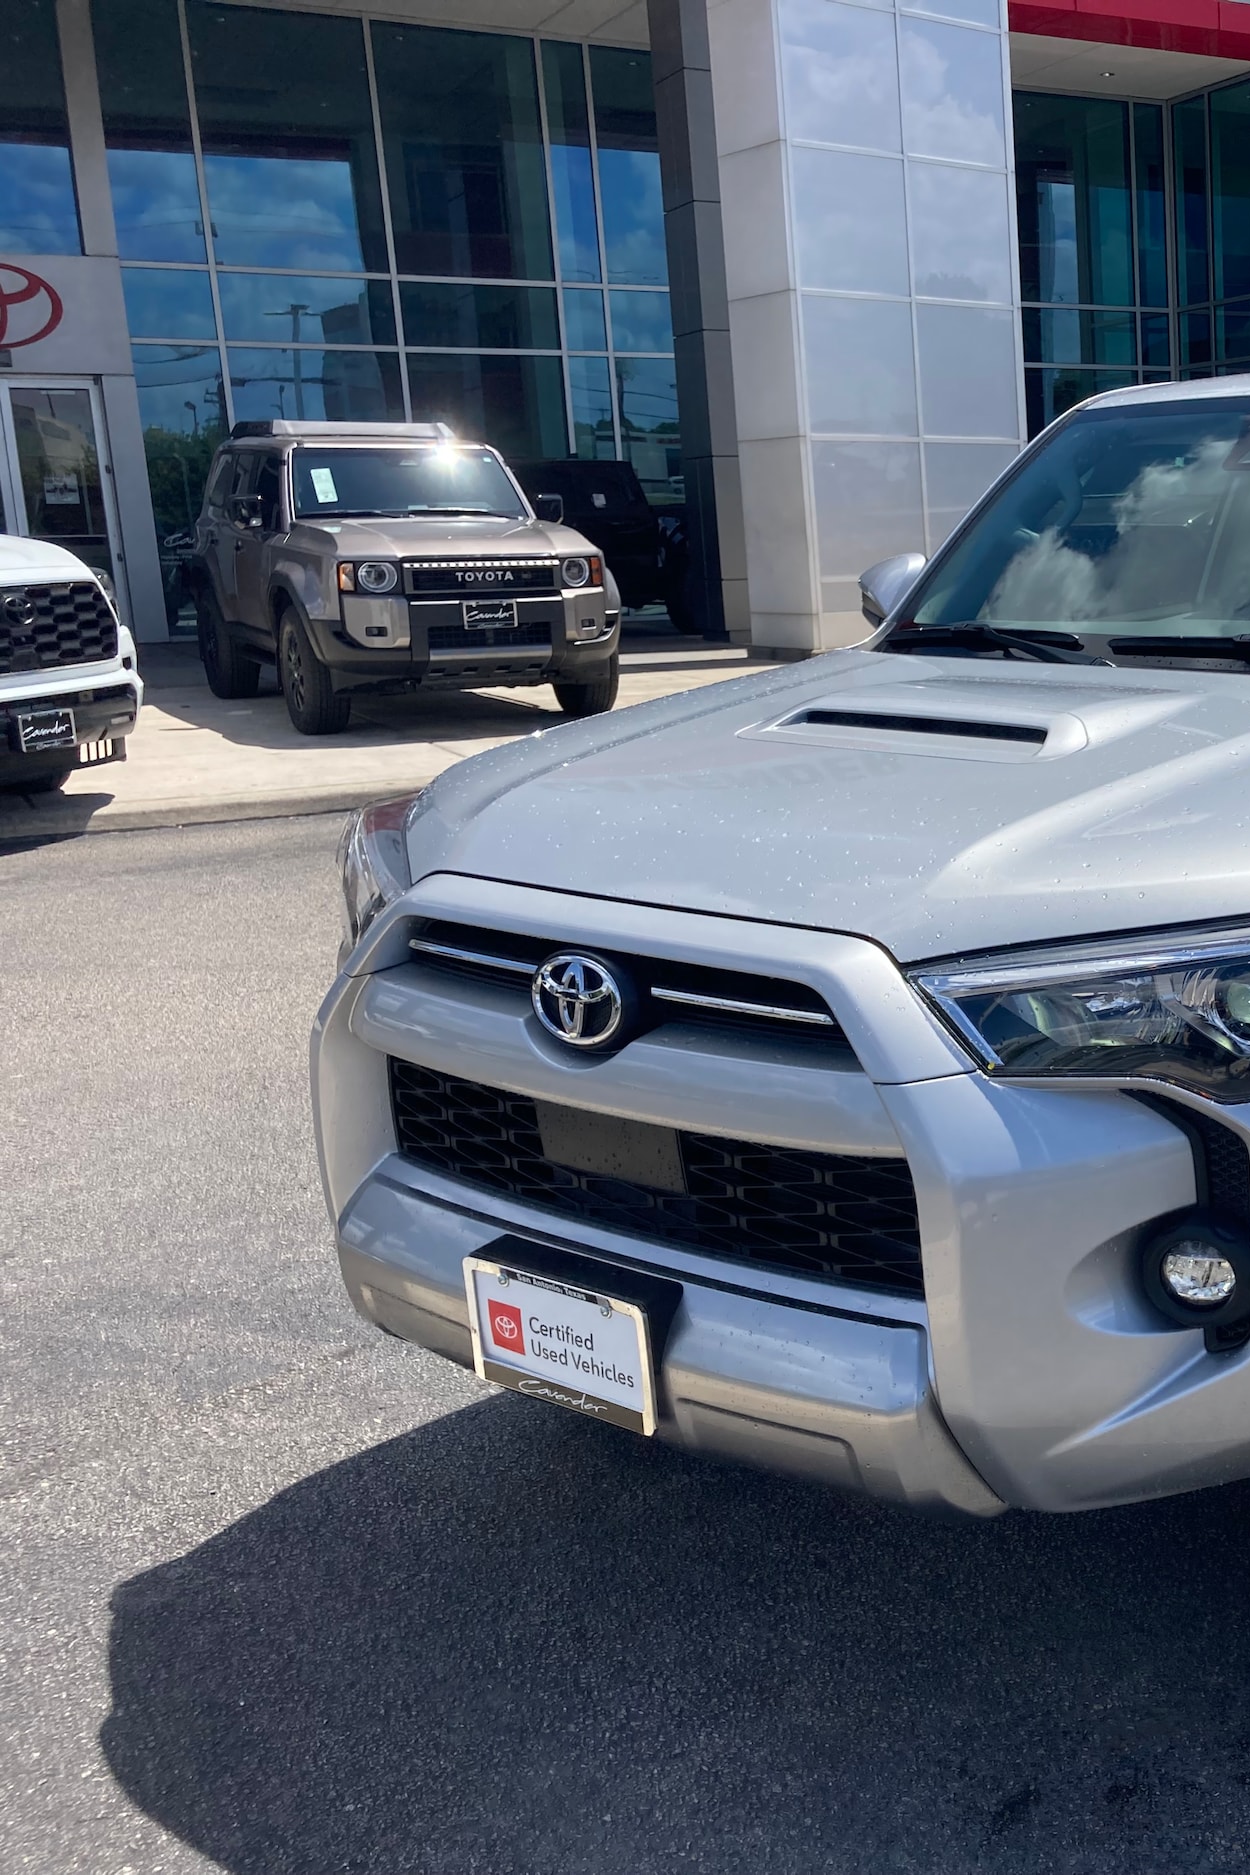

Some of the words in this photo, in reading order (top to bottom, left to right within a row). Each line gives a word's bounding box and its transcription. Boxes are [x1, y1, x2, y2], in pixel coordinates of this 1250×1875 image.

[455, 571, 514, 582] TOYOTA
[516, 1273, 531, 1282] San
[563, 1287, 587, 1301] Texas
[529, 1316, 594, 1351] Certified
[530, 1338, 568, 1367] Used
[570, 1350, 635, 1388] Vehicles
